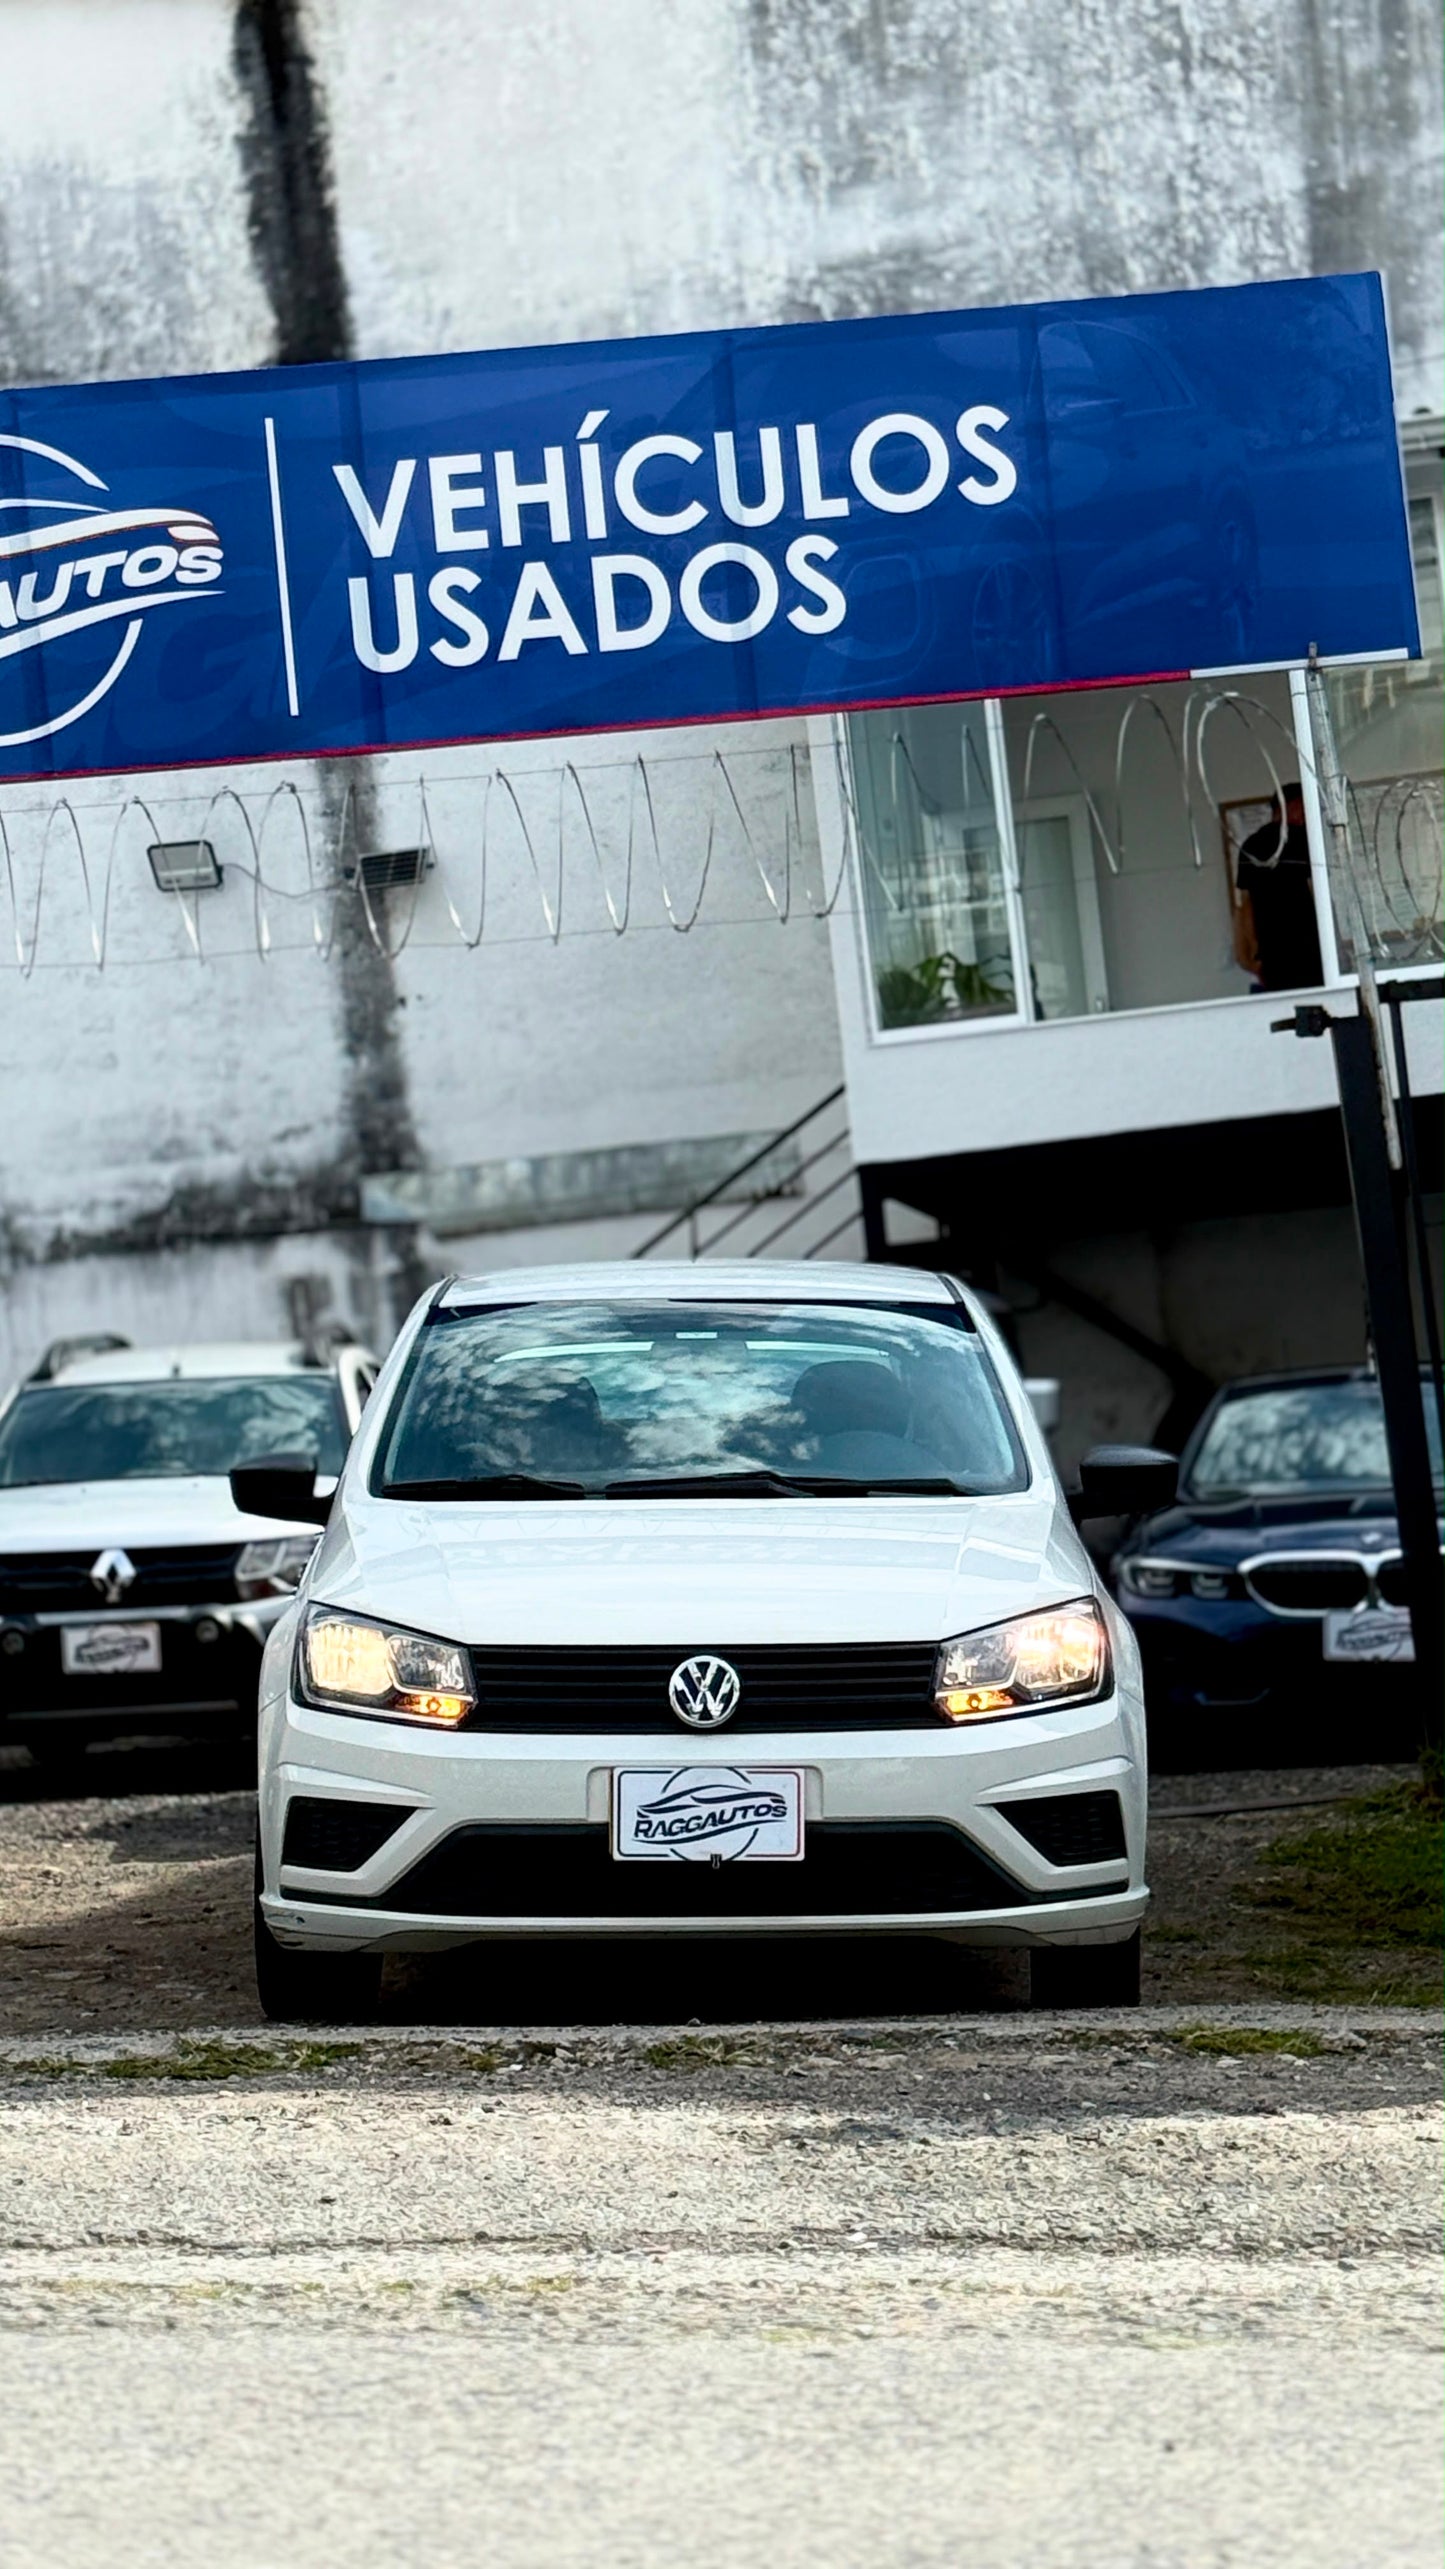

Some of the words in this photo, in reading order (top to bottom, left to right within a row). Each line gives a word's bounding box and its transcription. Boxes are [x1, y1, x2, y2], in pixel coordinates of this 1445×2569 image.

[332, 405, 1018, 560] VEHÍCULOS
[347, 534, 848, 674] USADOS
[634, 1804, 788, 1838] RAGGAUTOS
